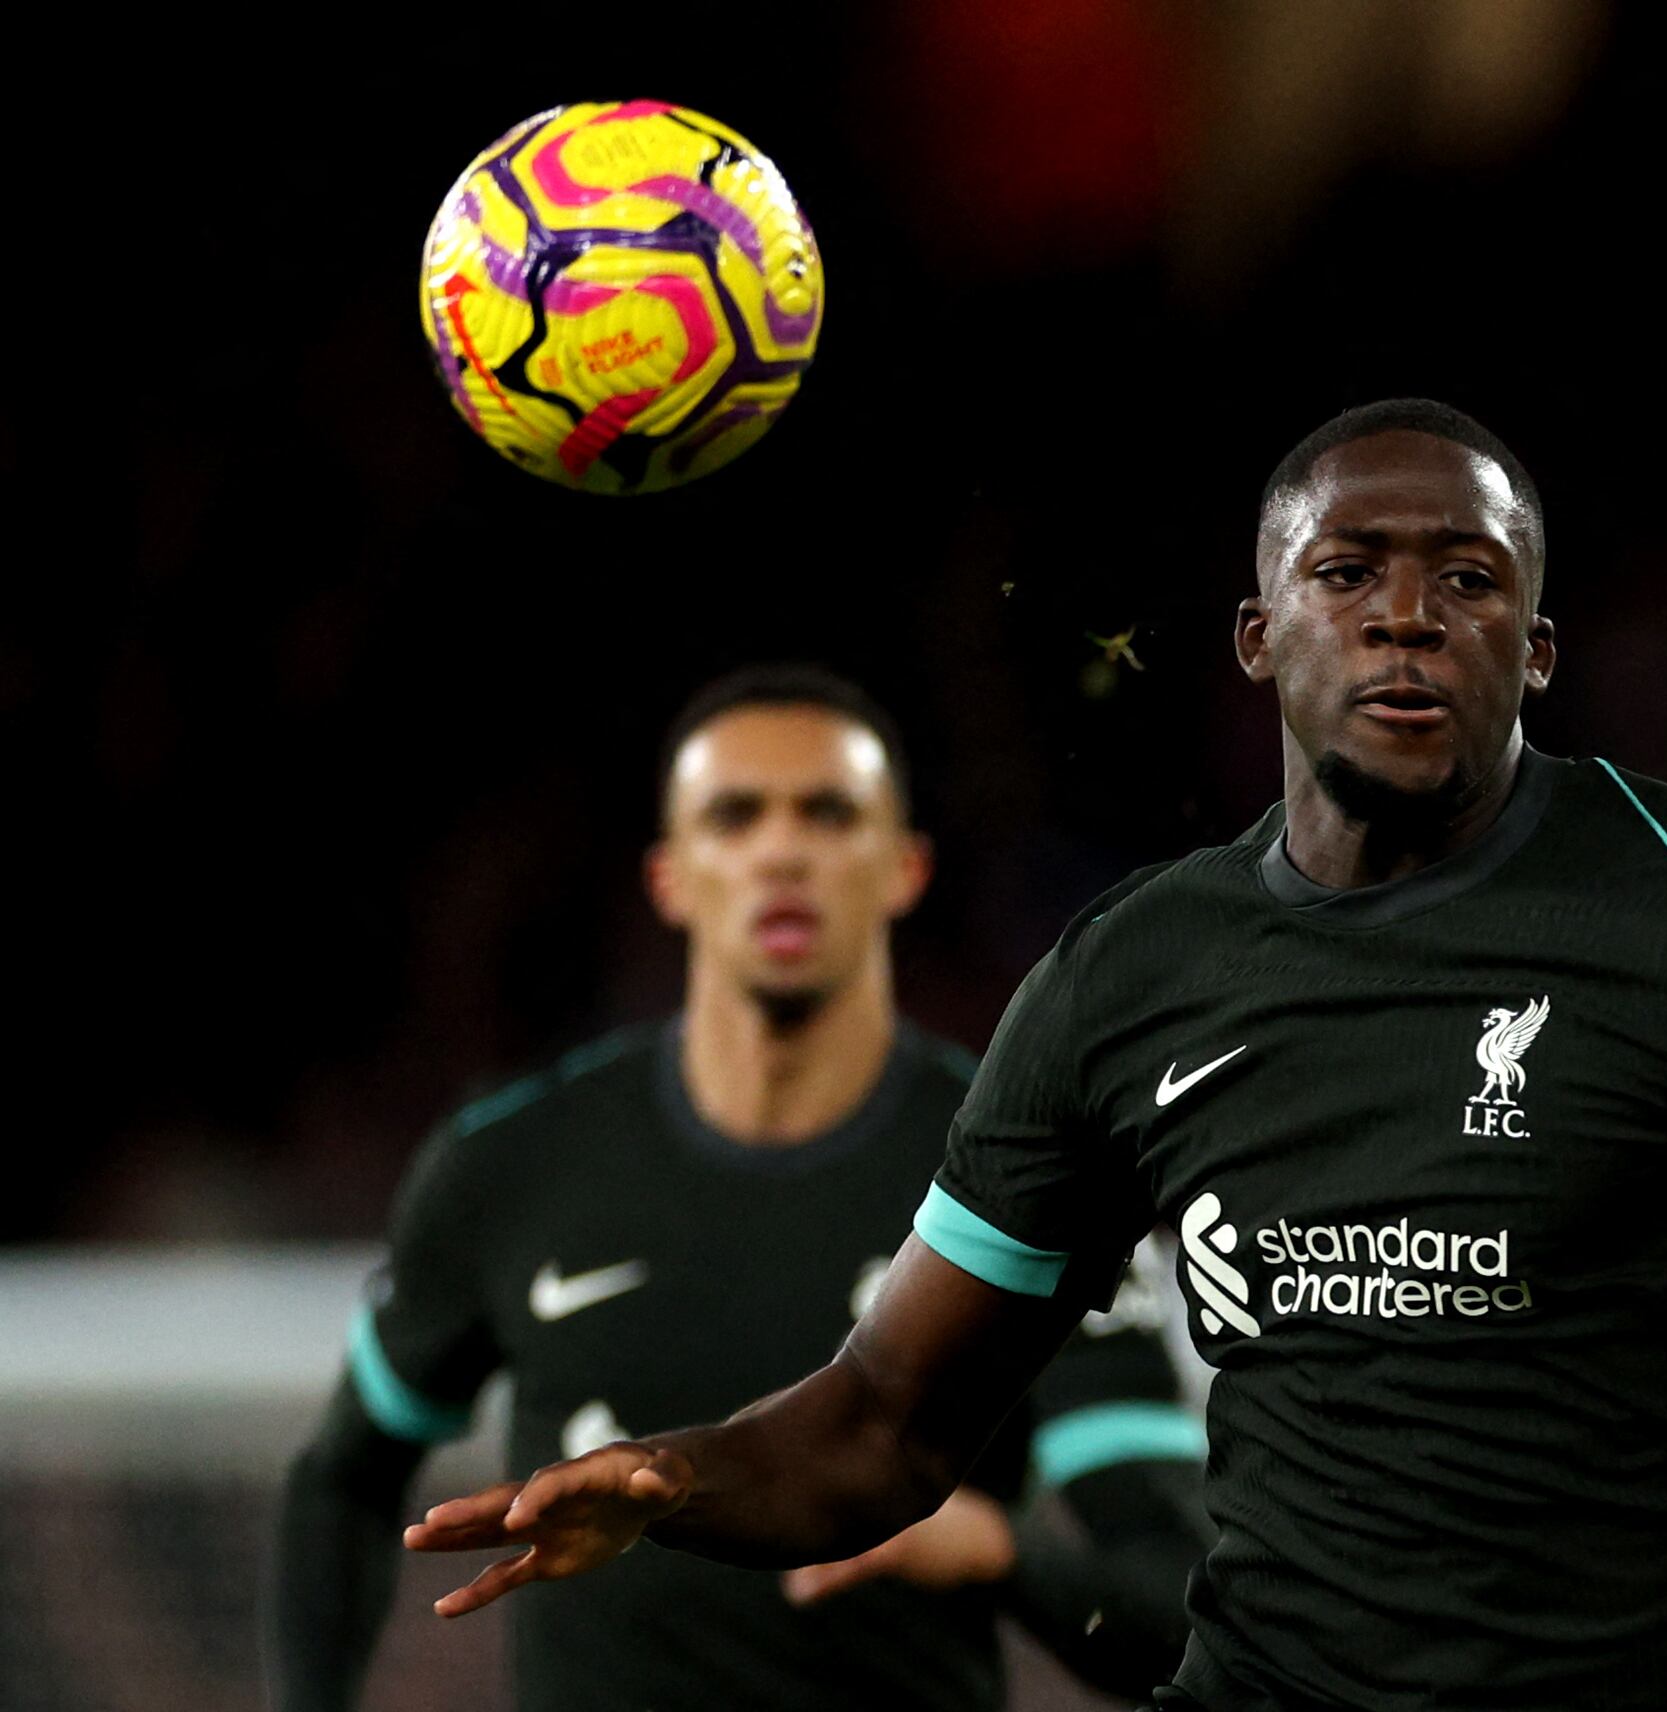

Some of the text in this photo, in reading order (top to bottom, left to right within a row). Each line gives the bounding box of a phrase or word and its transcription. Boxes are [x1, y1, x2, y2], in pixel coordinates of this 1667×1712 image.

[1462, 1105, 1531, 1138] L.F.C.
[1256, 1217, 1508, 1277] standard
[1271, 1264, 1532, 1318] chartered
